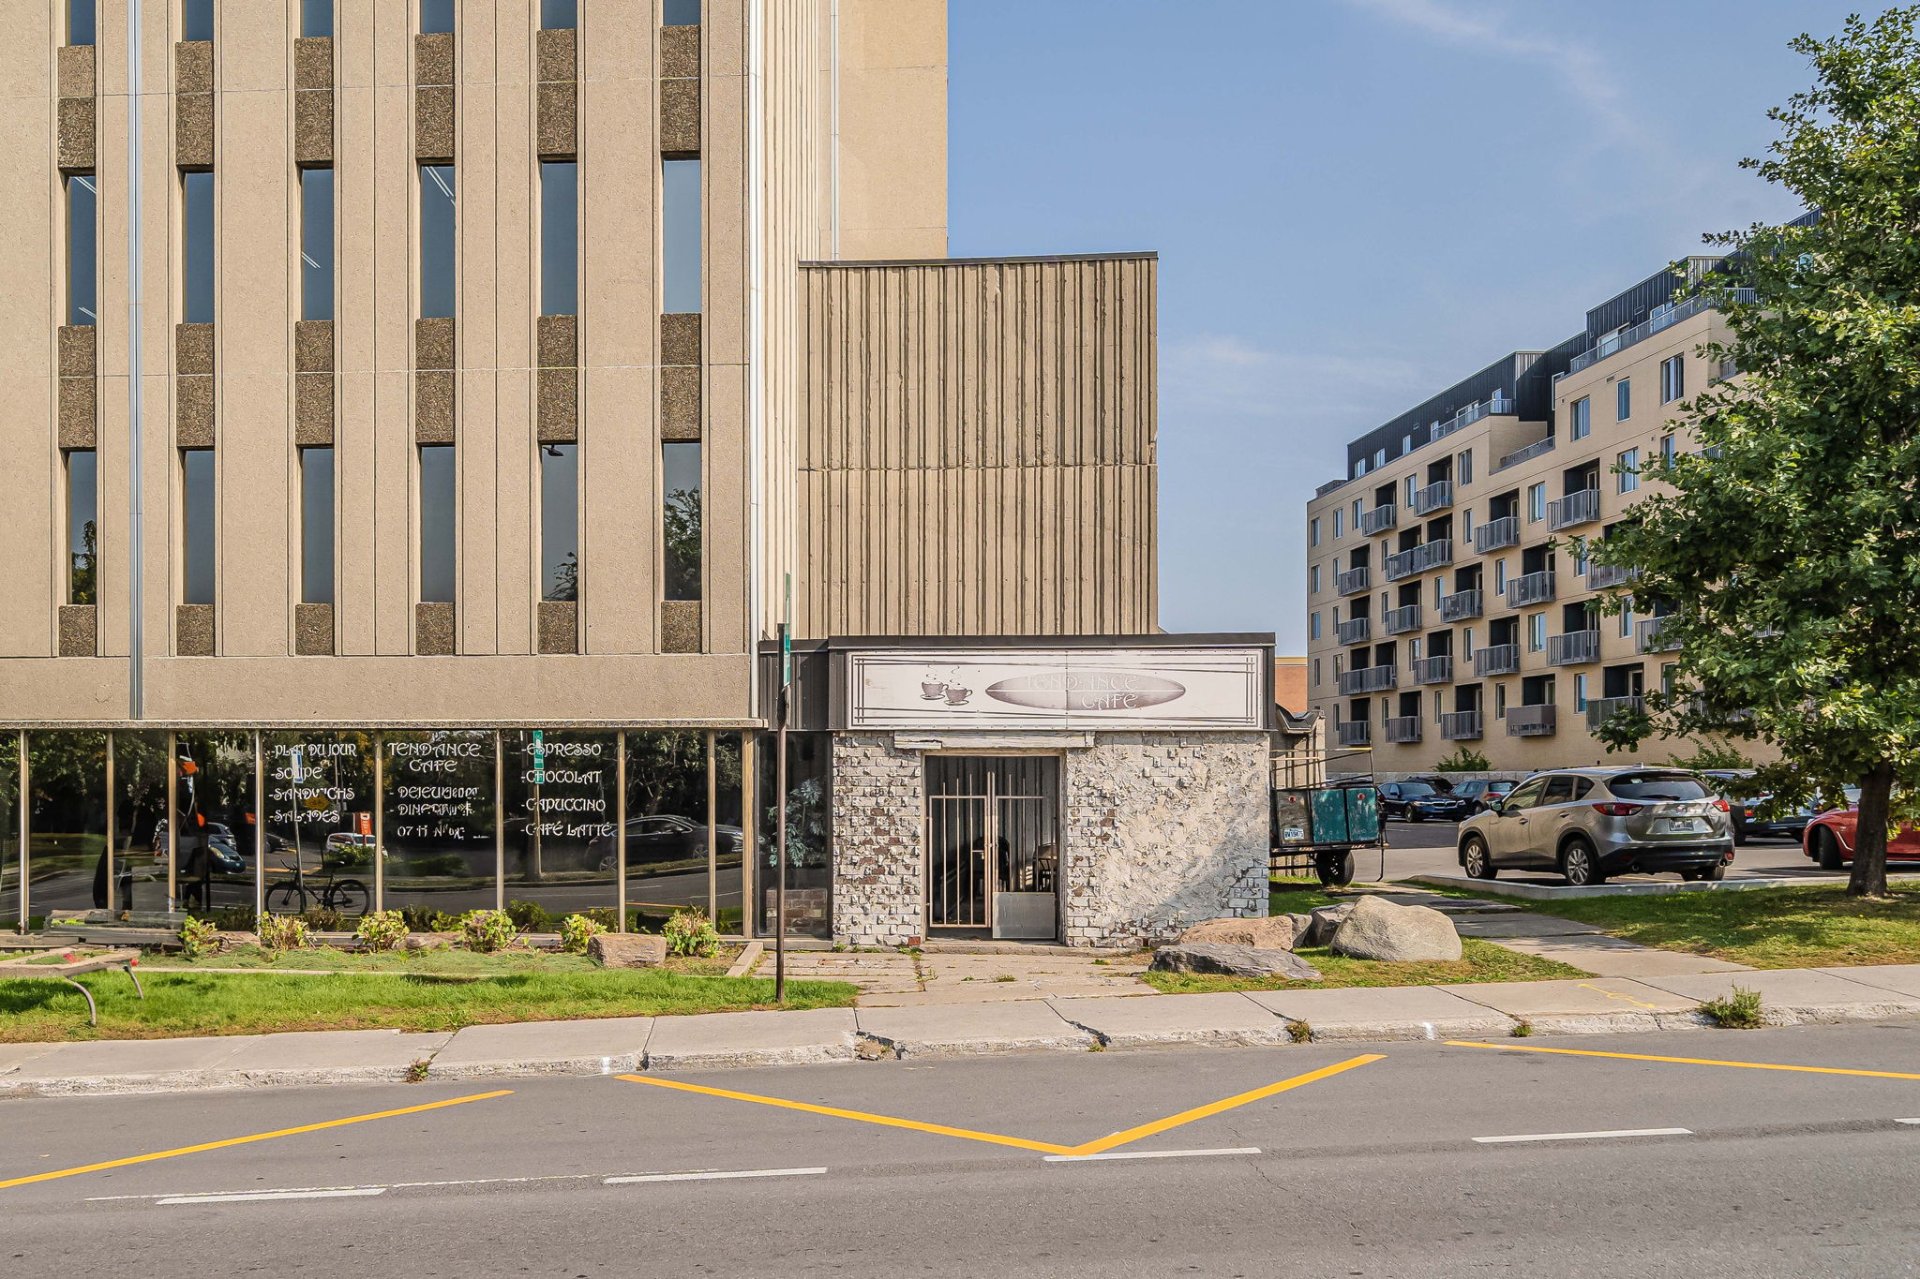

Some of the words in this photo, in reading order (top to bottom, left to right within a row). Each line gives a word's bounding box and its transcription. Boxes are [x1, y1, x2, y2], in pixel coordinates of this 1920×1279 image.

[308, 743, 326, 758] DU
[328, 743, 358, 758] JOUR
[387, 742, 482, 758] TENDANCE
[409, 759, 458, 773] CAFE
